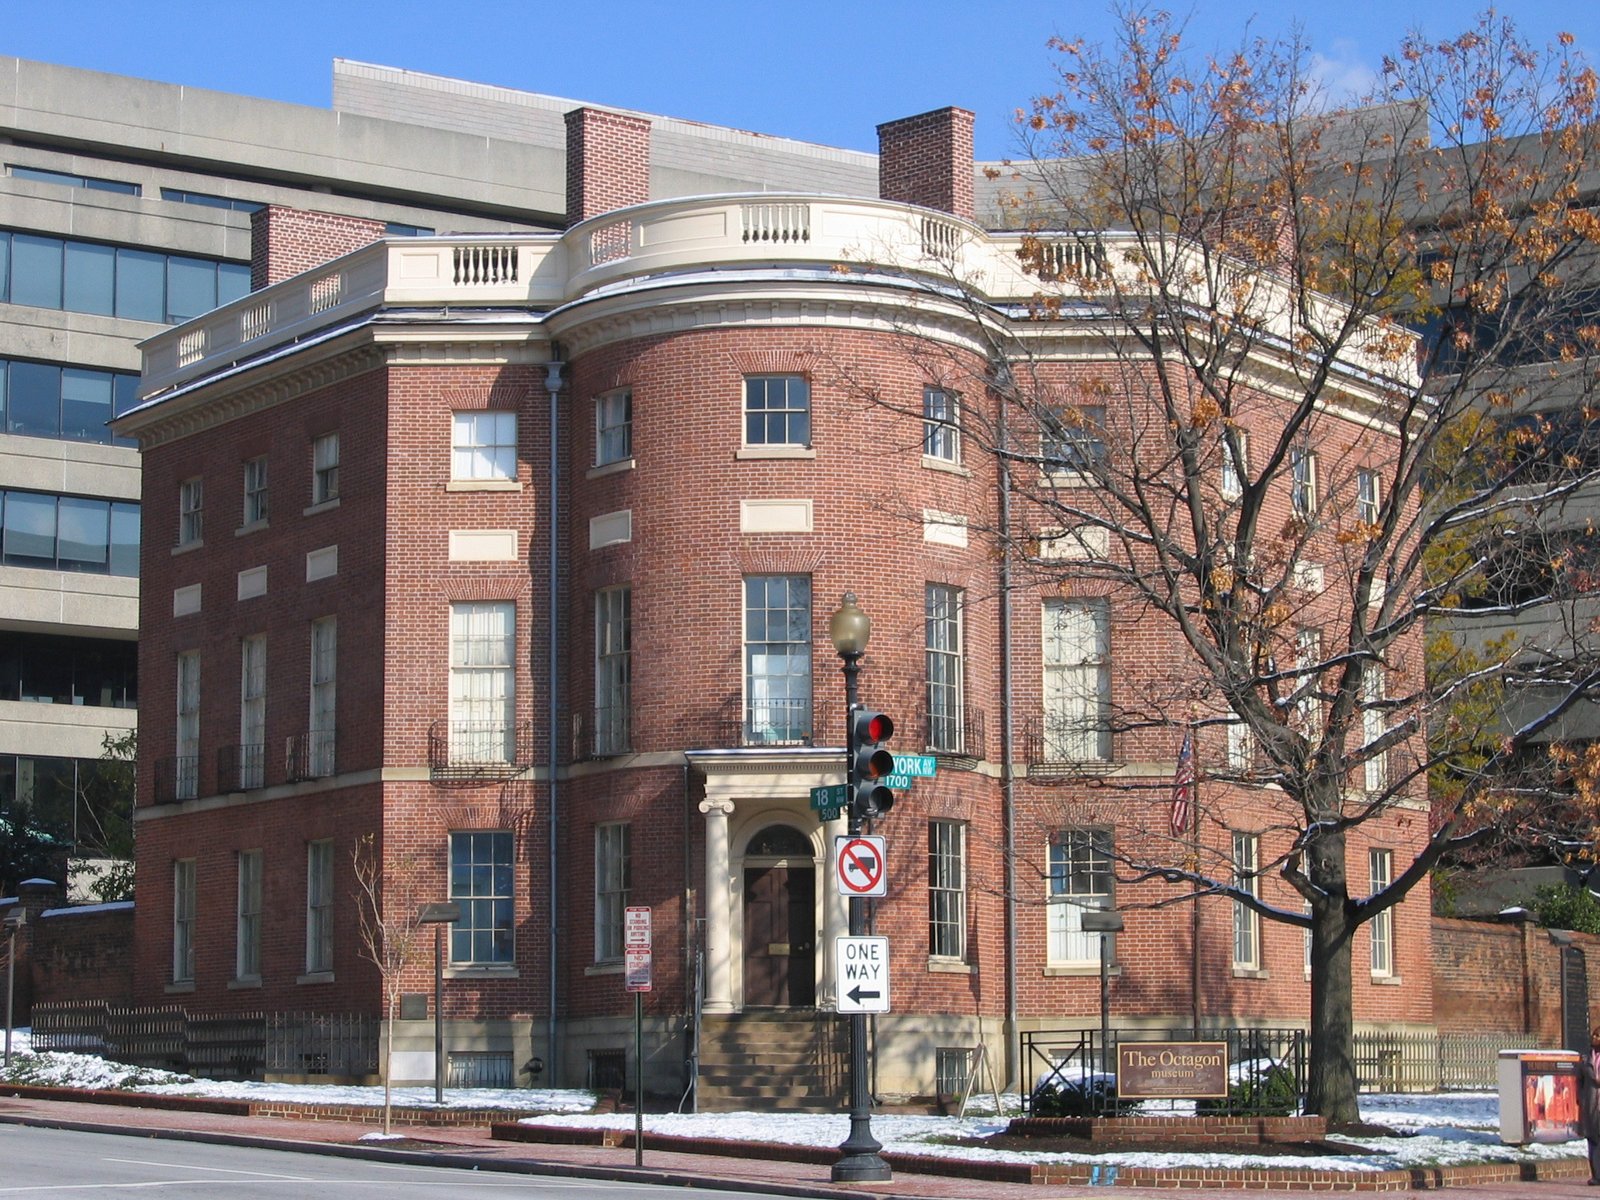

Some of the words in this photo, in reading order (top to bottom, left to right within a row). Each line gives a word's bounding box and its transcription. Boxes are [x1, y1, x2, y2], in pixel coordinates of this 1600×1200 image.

[893, 756, 921, 775] YORK
[922, 759, 932, 767] AV
[885, 775, 908, 787] 1700
[815, 789, 829, 806] 18
[822, 808, 838, 820] 500
[846, 943, 880, 960] ONE
[845, 963, 881, 980] WAY
[1123, 1050, 1156, 1067] The
[1159, 1050, 1221, 1070] Octagon
[1151, 1069, 1195, 1078] museum
